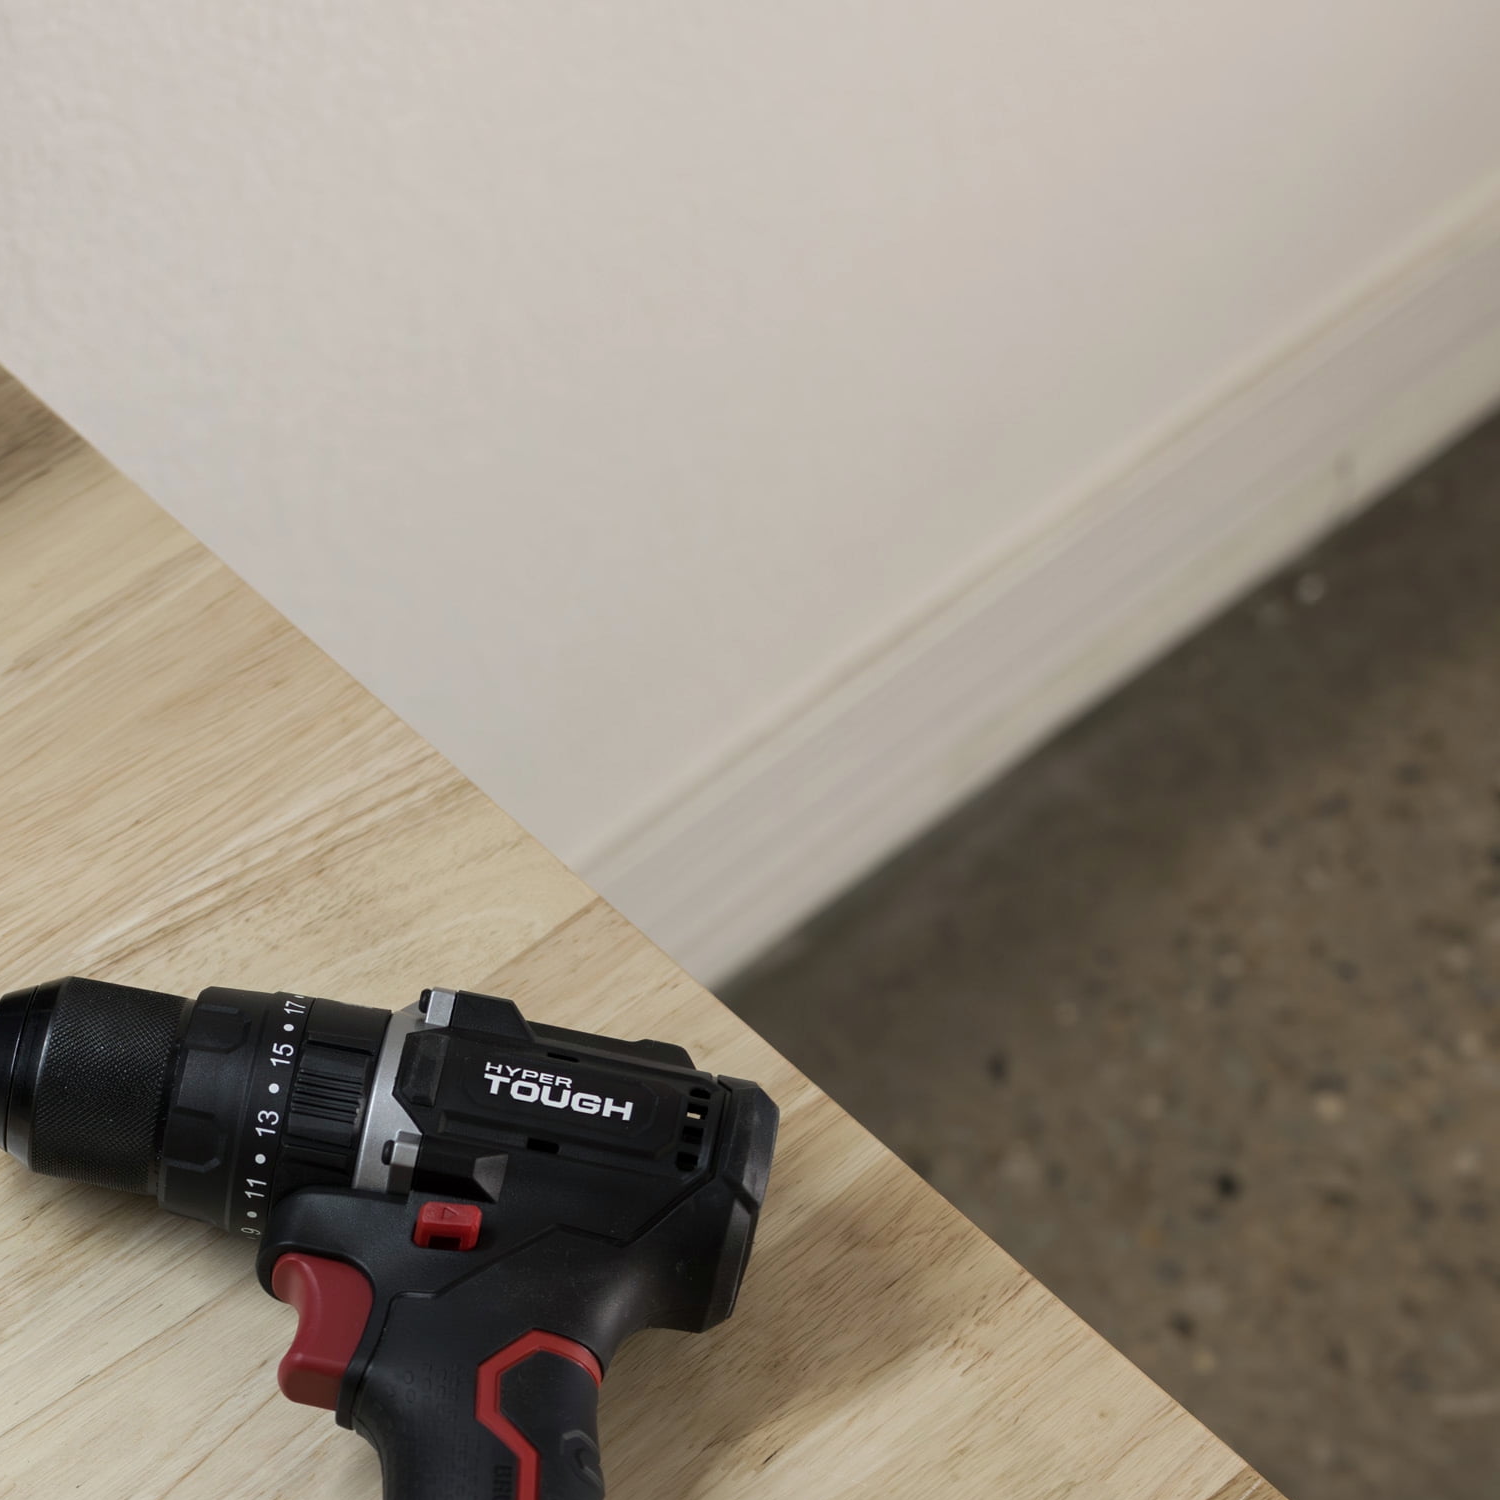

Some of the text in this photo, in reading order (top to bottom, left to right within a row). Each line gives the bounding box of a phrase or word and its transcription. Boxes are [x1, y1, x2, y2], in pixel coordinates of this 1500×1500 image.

[283, 1000, 307, 1015] 17
[269, 1042, 295, 1067] 15
[484, 1061, 573, 1089] HYPER
[483, 1073, 634, 1122] TOUGH
[255, 1109, 280, 1137] 13
[244, 1178, 268, 1199] 11
